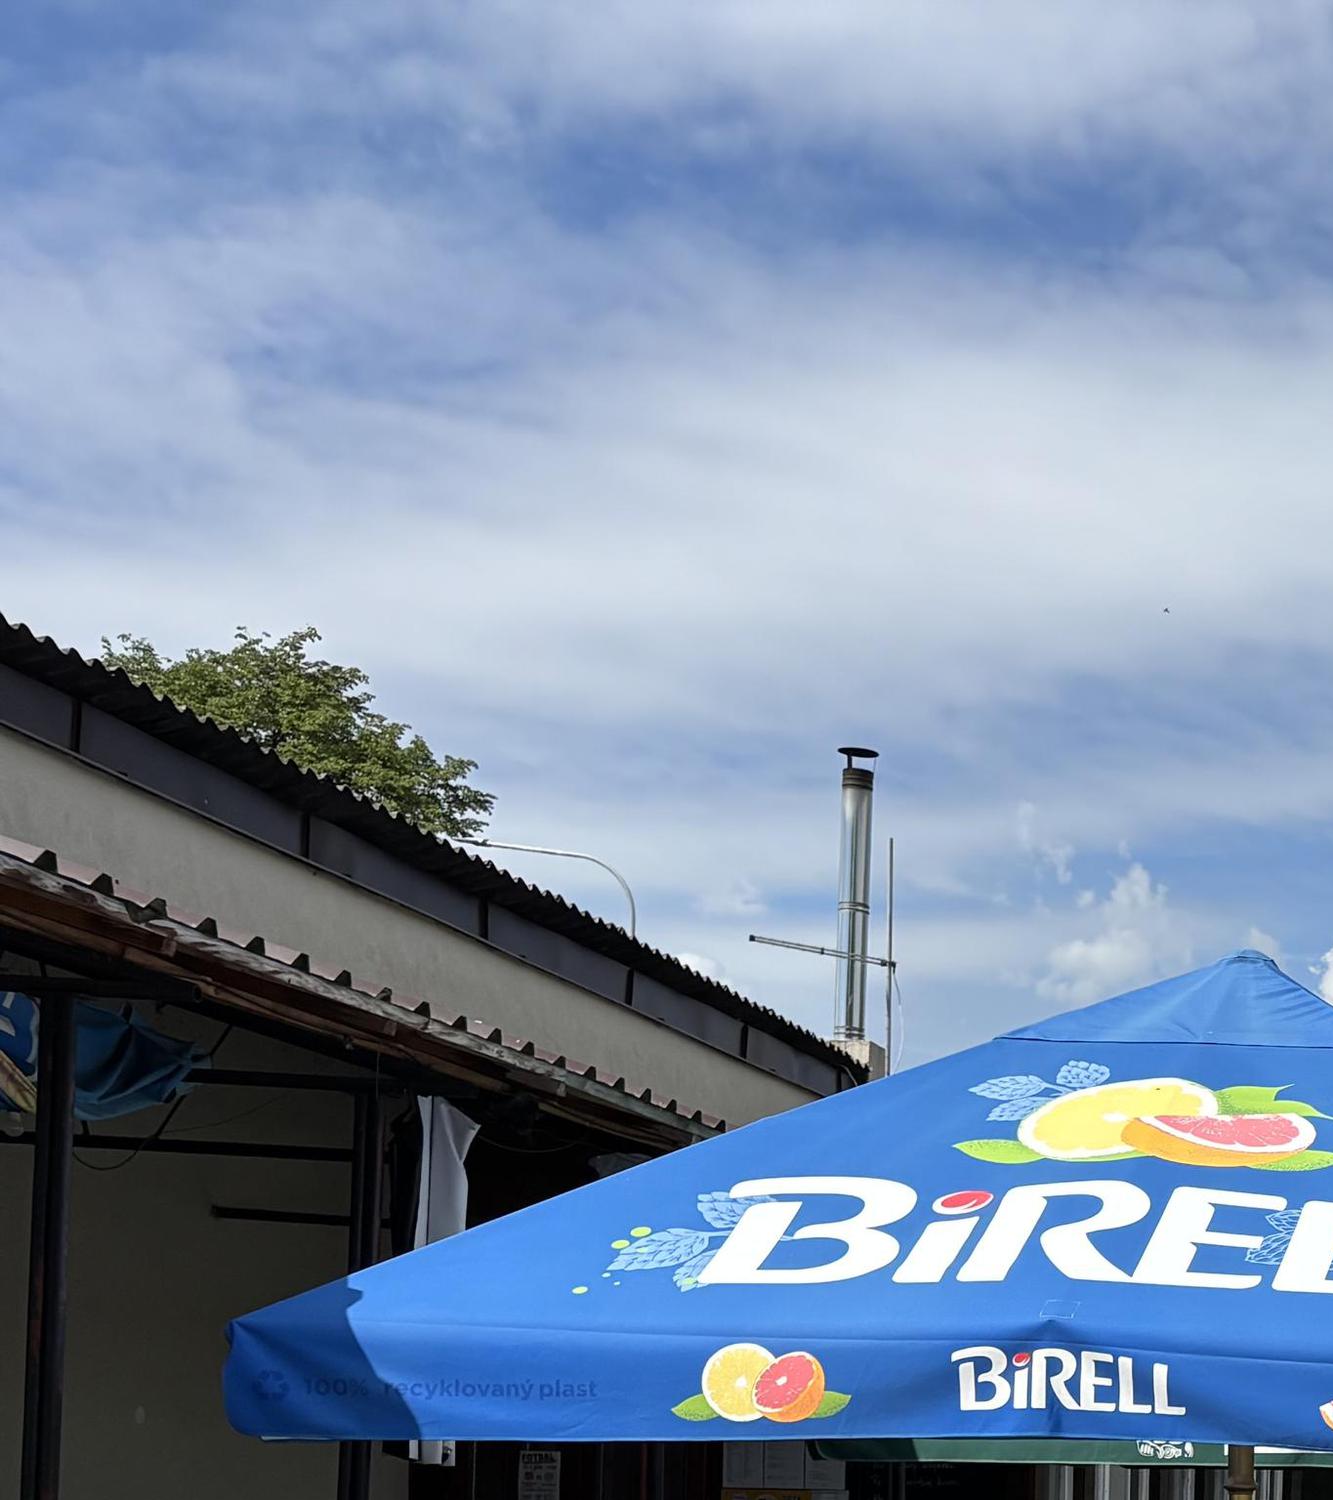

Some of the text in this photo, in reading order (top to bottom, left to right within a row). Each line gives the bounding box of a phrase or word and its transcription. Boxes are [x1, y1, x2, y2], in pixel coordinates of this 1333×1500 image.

[303, 1377, 598, 1401] 100% recyklovaný plast
